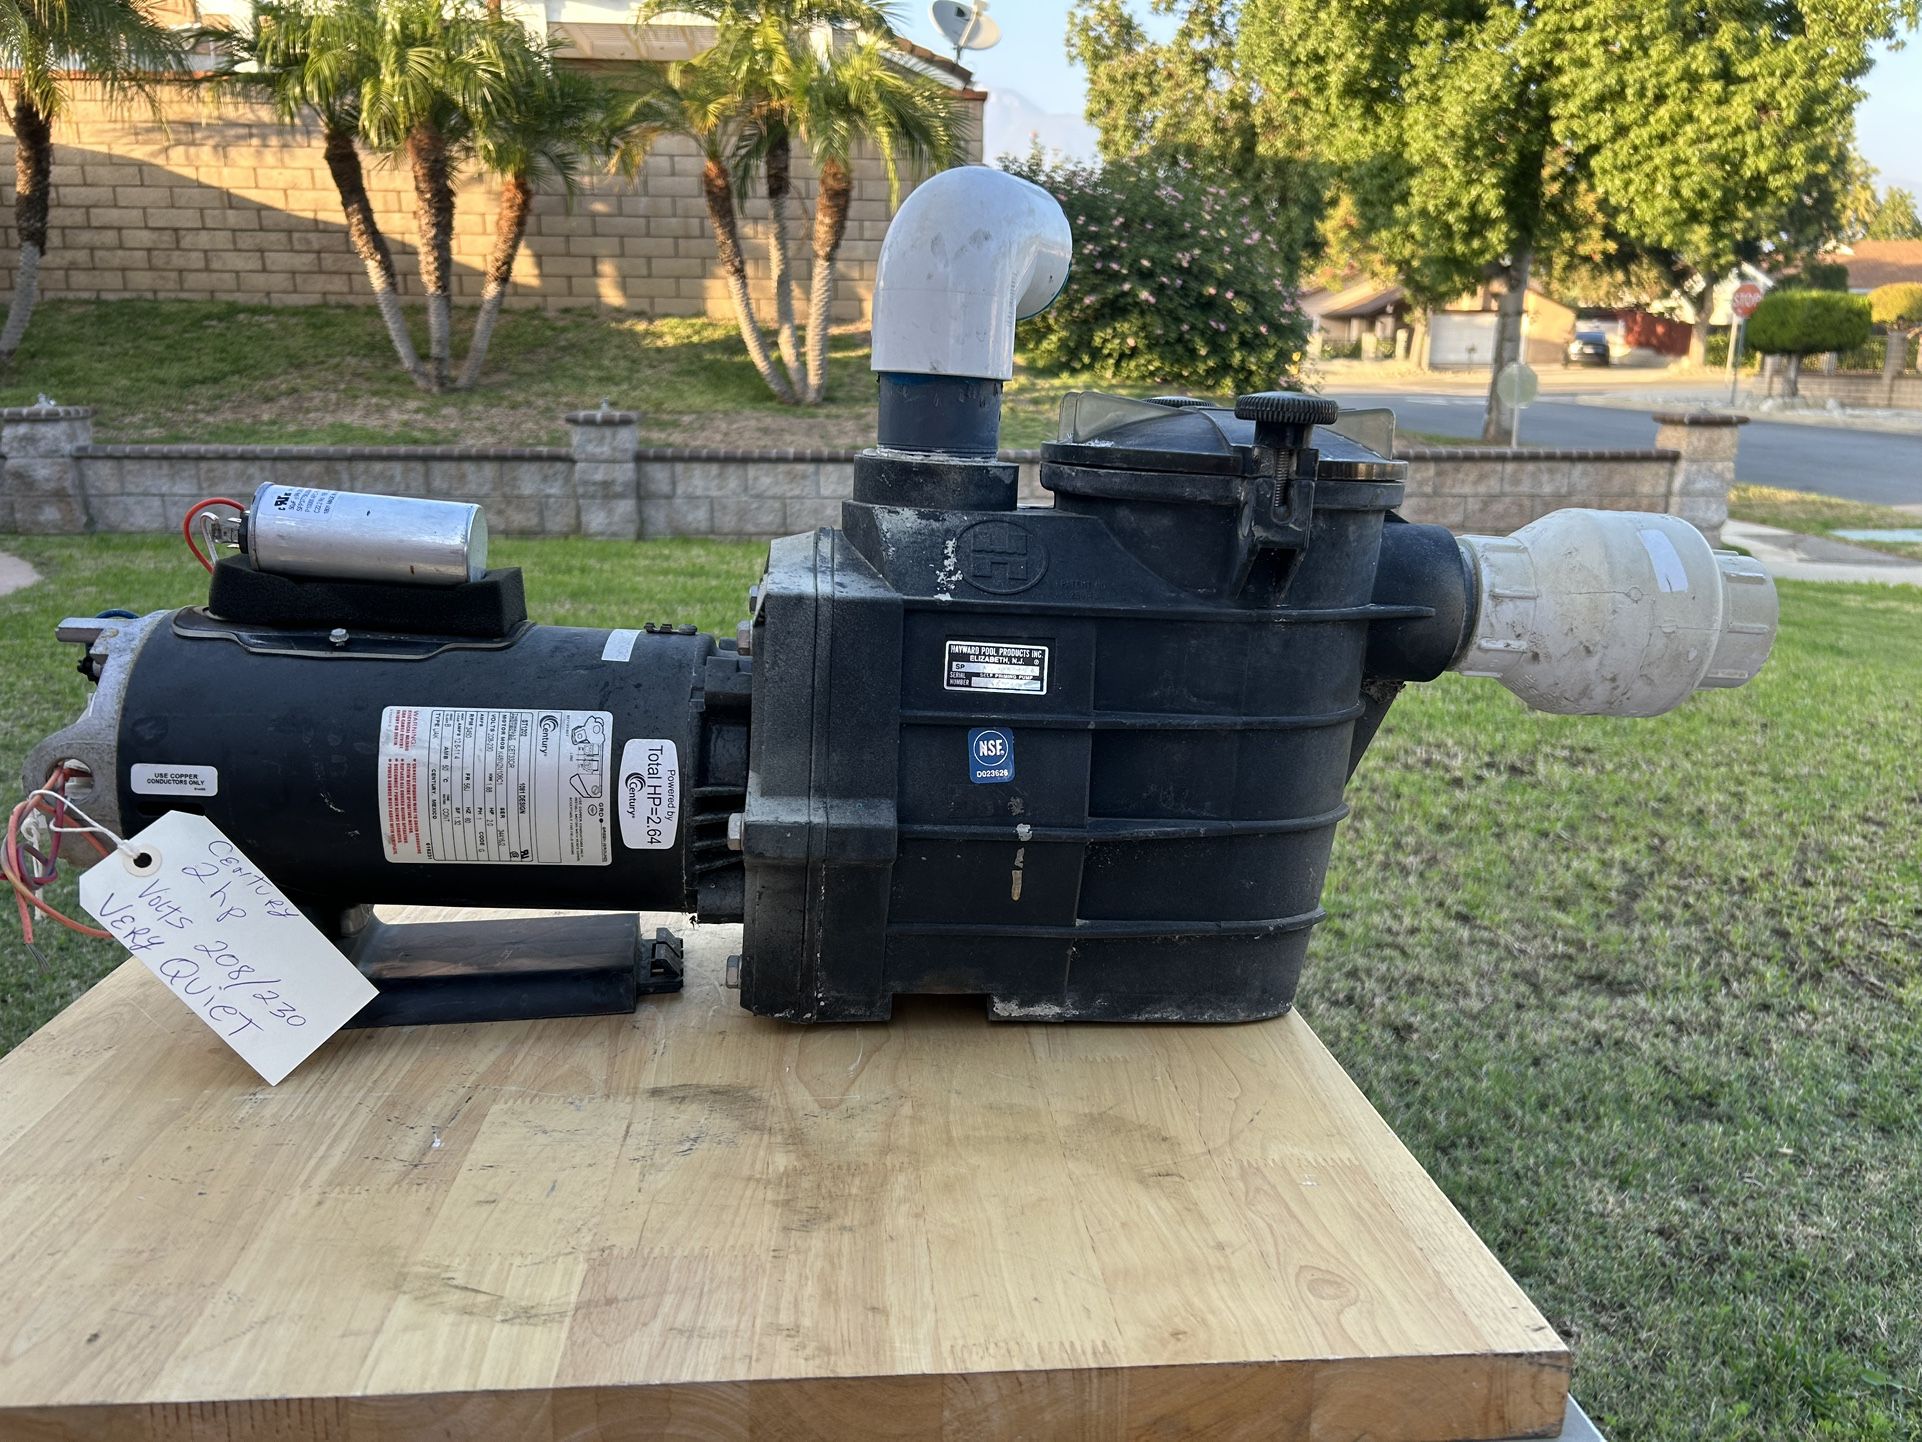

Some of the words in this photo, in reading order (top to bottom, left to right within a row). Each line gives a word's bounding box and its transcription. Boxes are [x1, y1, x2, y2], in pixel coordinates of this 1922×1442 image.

[1733, 292, 1761, 308] STOP
[950, 645, 980, 655] HAYWARD
[981, 647, 997, 656] POOL
[999, 648, 1029, 658] PRODUCTS
[1031, 650, 1044, 659] INC.
[970, 655, 1010, 664] ELIZABETH,
[1012, 657, 1025, 665] N.J.
[979, 740, 1003, 756] NSF
[647, 745, 663, 779] Total
[667, 770, 676, 808] Powered
[442, 808, 450, 822] CONT
[647, 784, 662, 844] HP=2.64
[665, 811, 675, 821] by
[181, 861, 220, 884] 2
[193, 940, 306, 1026] 208/230
